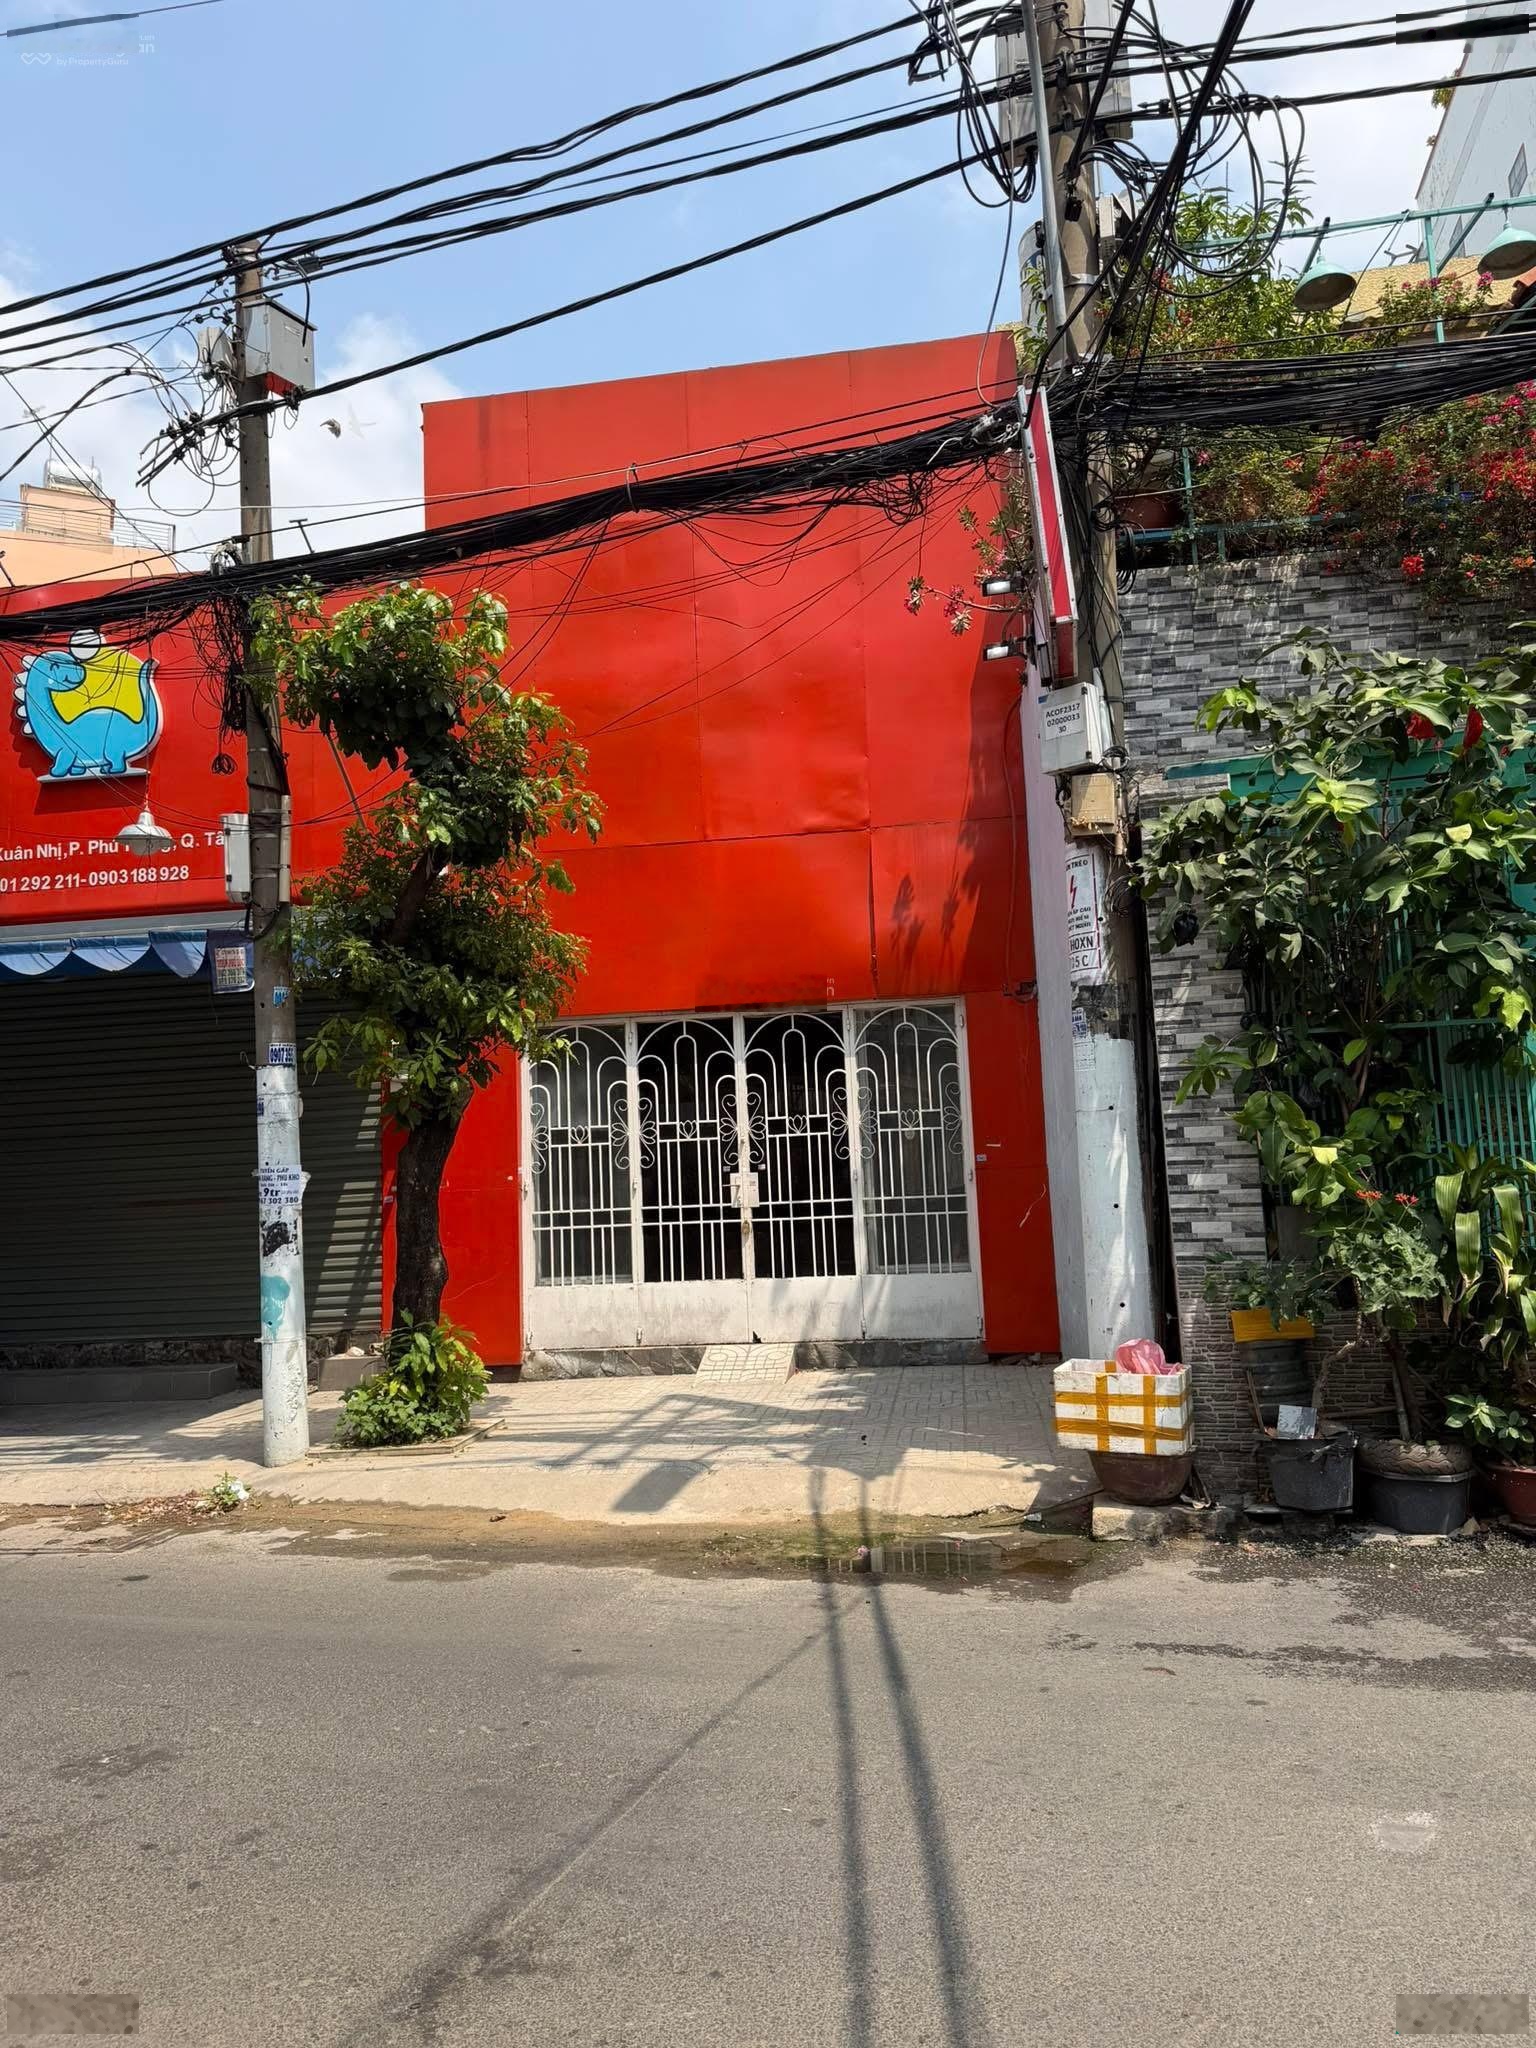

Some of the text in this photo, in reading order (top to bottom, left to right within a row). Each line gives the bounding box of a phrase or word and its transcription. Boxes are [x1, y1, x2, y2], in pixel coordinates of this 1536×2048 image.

[88, 839, 119, 854] Phú
[181, 833, 200, 848] Q.
[204, 830, 225, 846] Tâ
[20, 875, 51, 891] 292
[130, 867, 157, 883] 188
[160, 865, 189, 880] 928
[263, 1187, 281, 1197] 9tr
